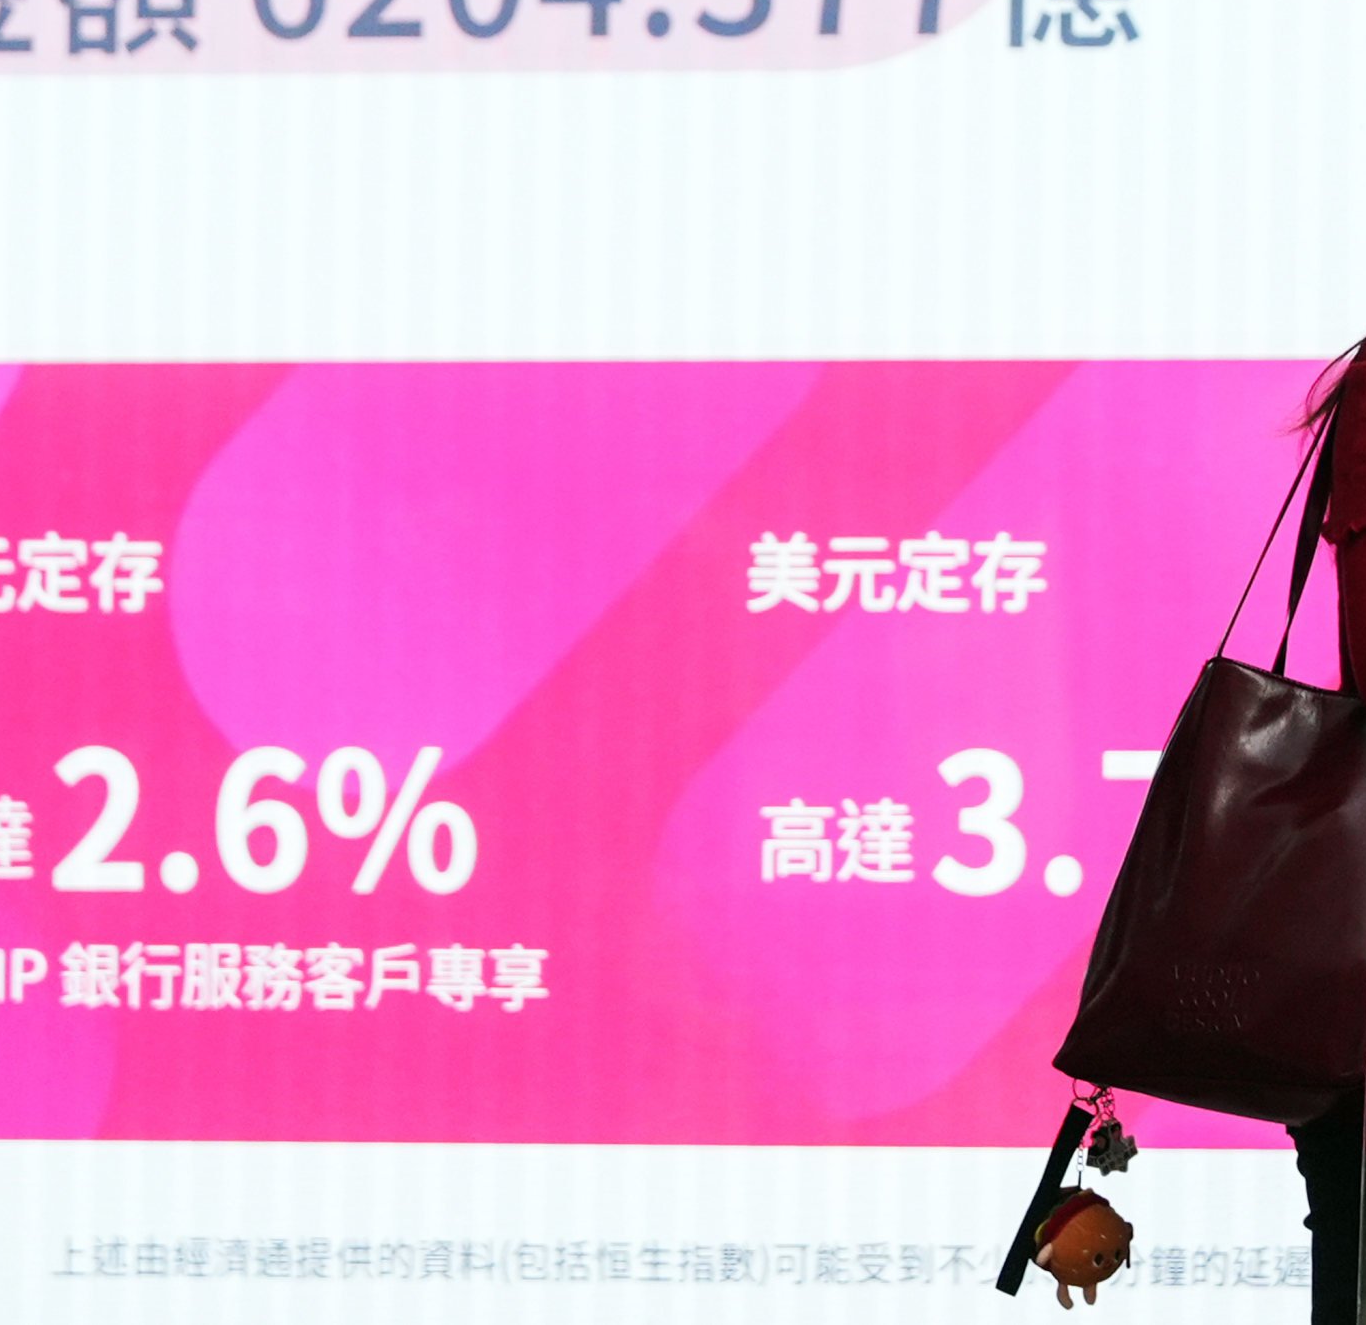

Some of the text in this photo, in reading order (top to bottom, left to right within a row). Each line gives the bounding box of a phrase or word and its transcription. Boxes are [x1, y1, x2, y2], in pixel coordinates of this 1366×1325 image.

[746, 530, 1048, 613] 美元定存
[931, 747, 1163, 896] 3.
[59, 940, 549, 1012] 銀行服務客戶專享
